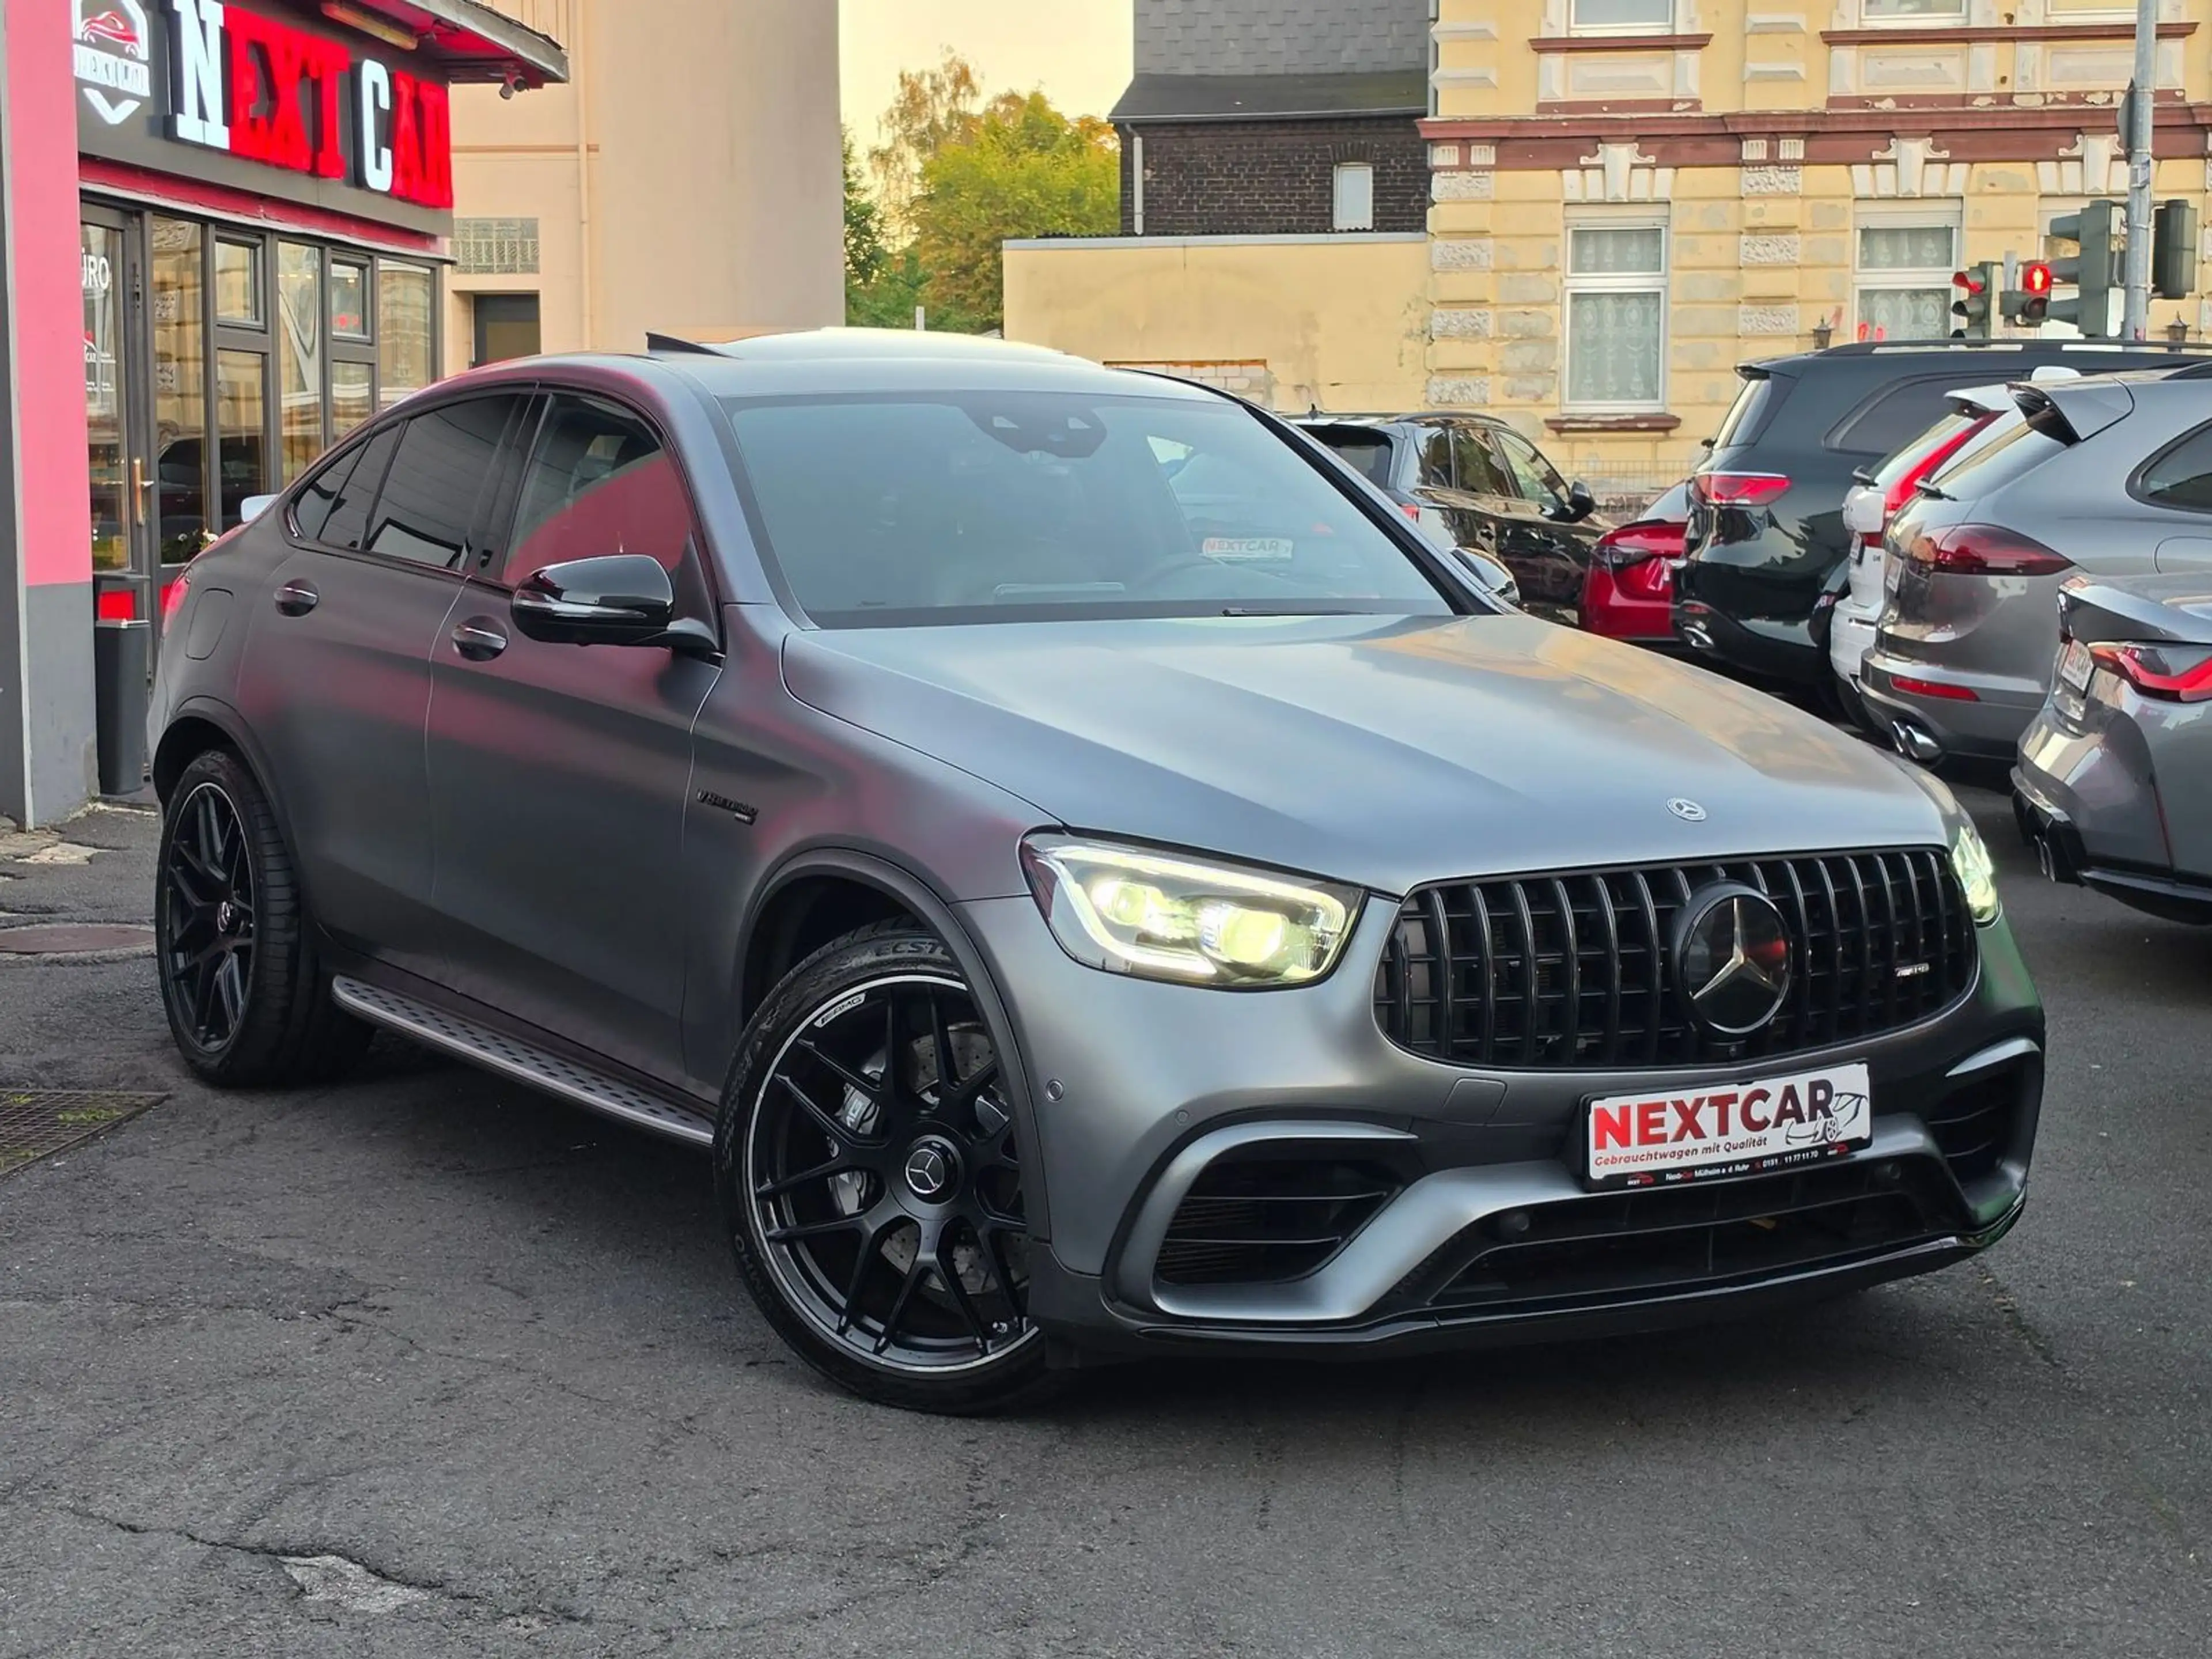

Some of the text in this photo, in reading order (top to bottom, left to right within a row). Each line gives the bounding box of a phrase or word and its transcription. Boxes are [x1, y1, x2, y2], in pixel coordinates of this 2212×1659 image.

[172, 0, 454, 209] NEXT CAR
[1593, 1078, 1834, 1150] NEXTCAR
[1594, 1136, 1768, 1166] Gebrauchtwagen mit Qualität
